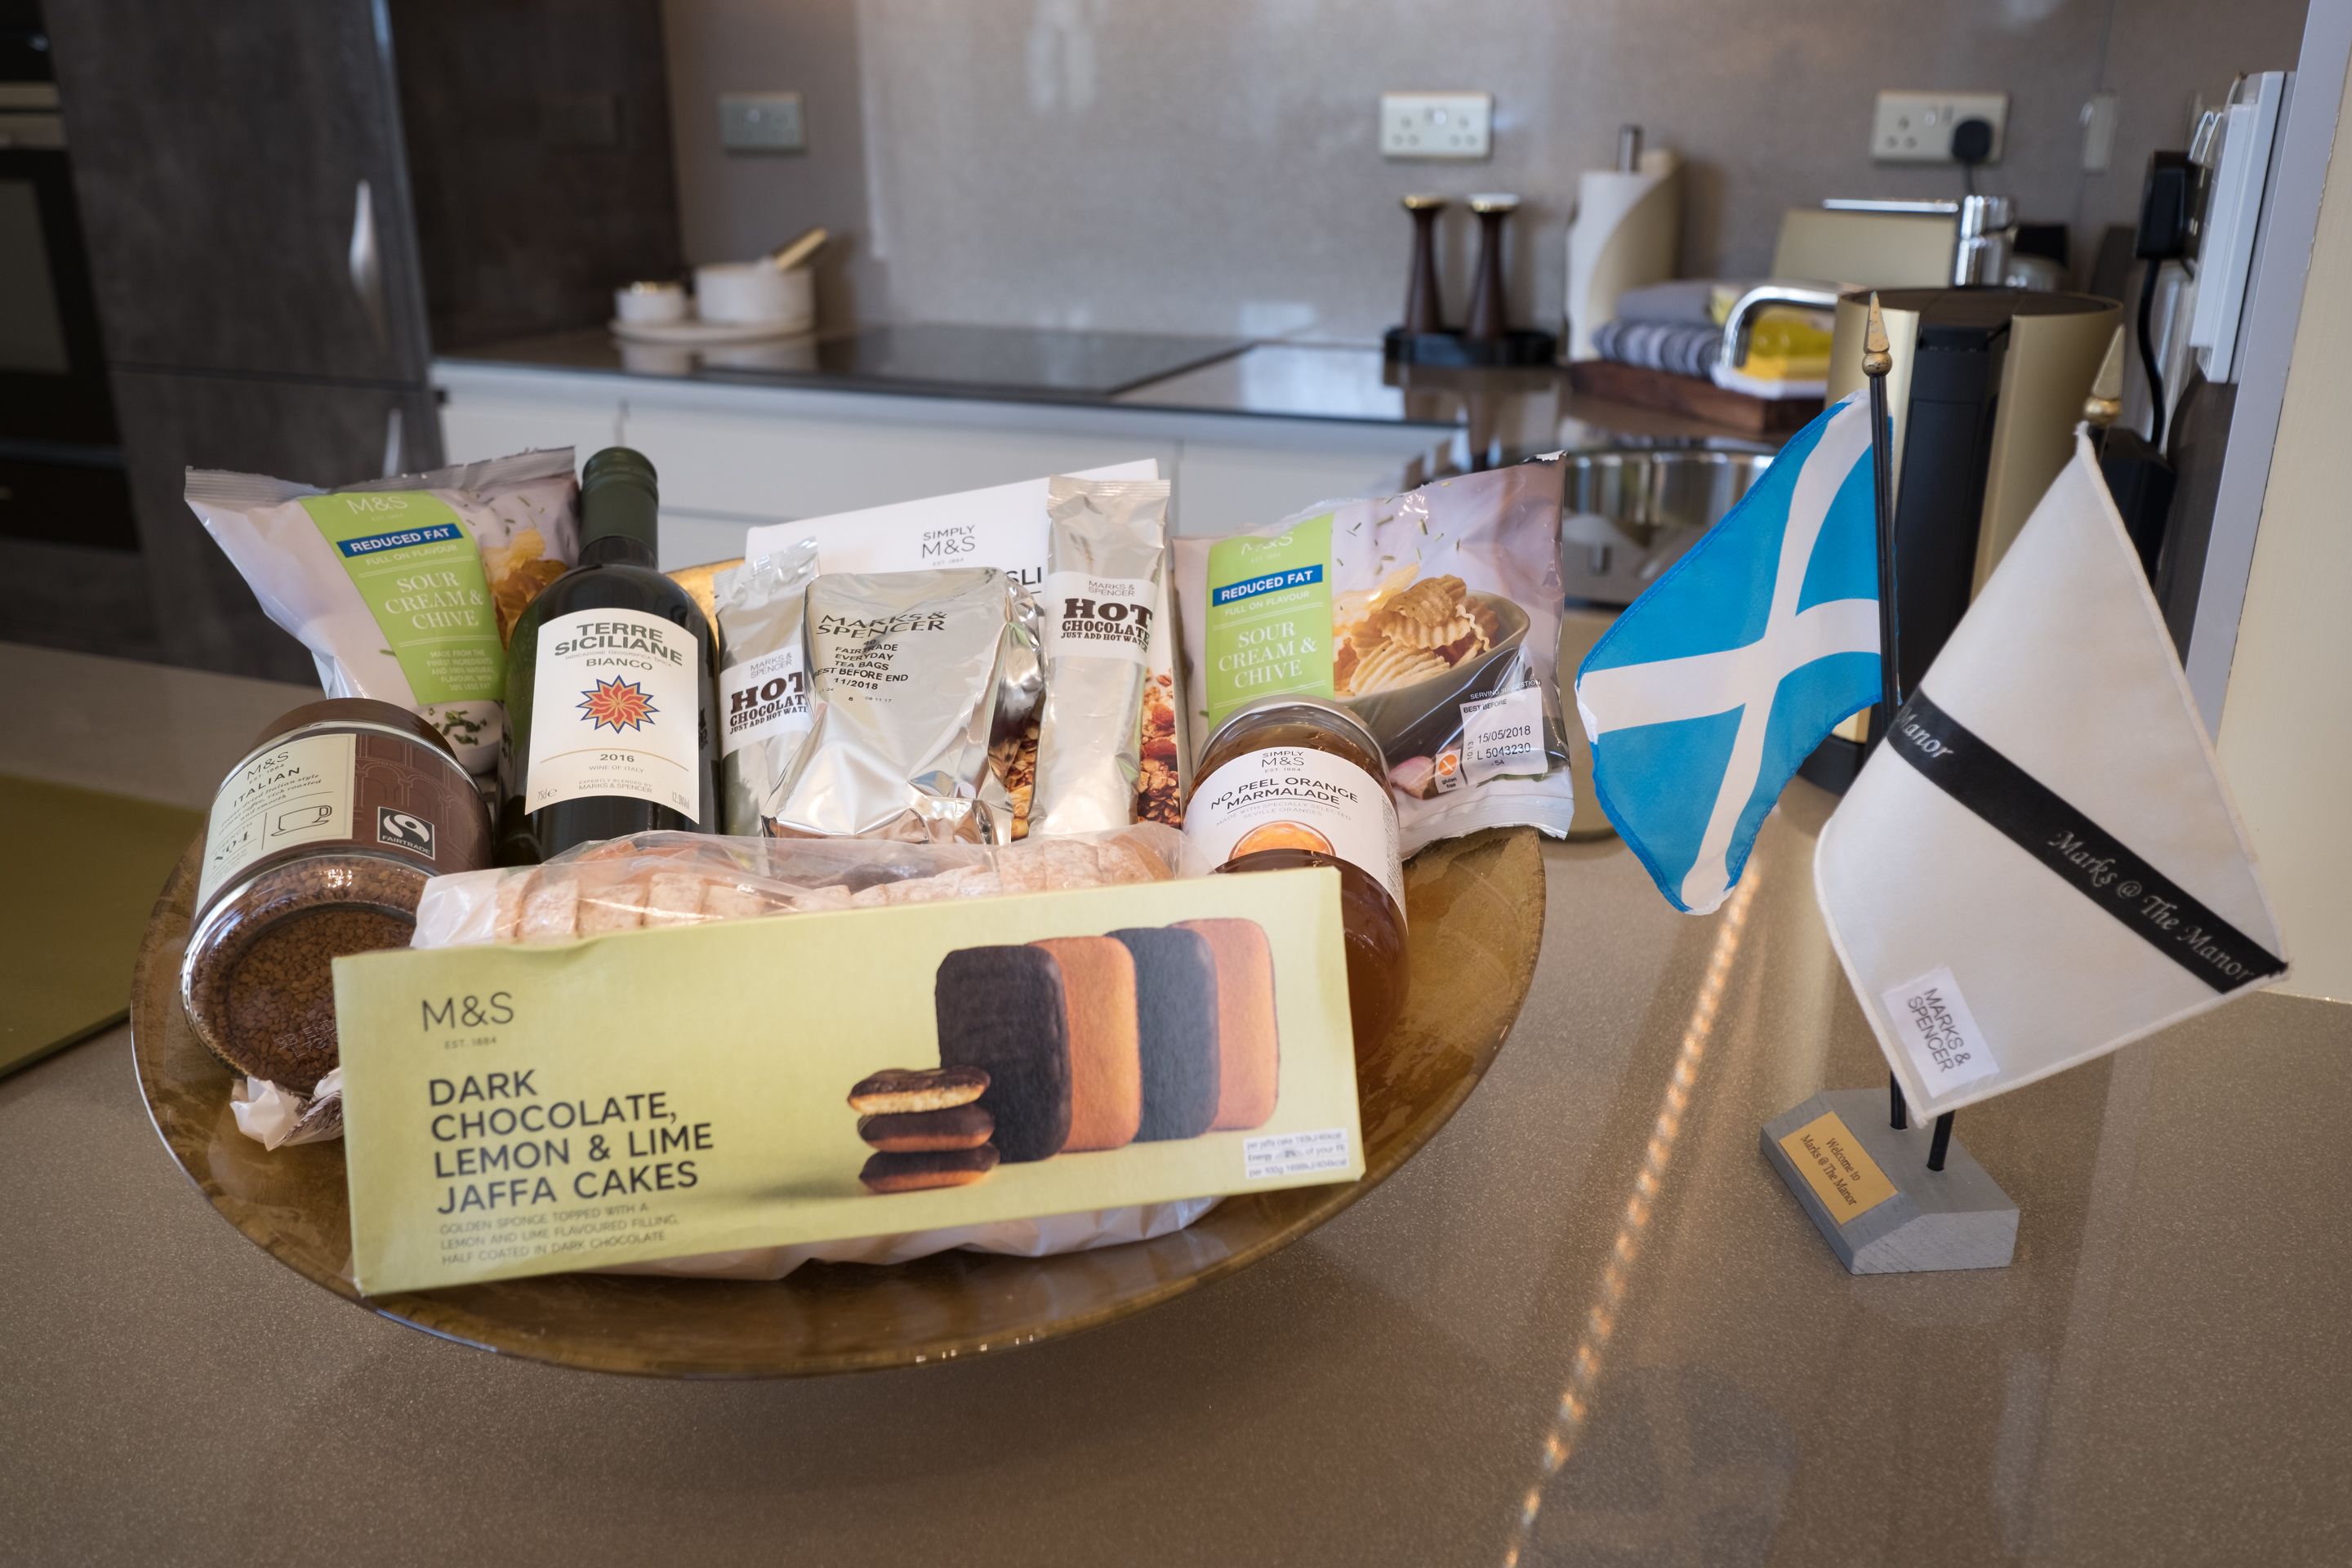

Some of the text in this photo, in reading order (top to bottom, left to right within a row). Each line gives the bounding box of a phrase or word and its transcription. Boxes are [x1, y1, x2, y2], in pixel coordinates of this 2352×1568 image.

[346, 496, 408, 515] M&S
[350, 528, 451, 553] REDUCED FAT
[924, 524, 976, 541] SIMPLY
[366, 544, 458, 566] FULL ON FLAVOUR
[922, 536, 976, 559] M&S
[397, 572, 460, 594] SOUR
[1088, 586, 1135, 597] SPENCER
[1089, 581, 1126, 590] MARKS
[1221, 570, 1314, 601] REDUCED FAT
[385, 589, 484, 614] CREAM &
[1225, 590, 1311, 617] FULL ON FLAVOUR
[412, 609, 479, 630] CHIVE
[821, 612, 948, 629] MARKS &
[1063, 598, 1153, 631] HOT
[577, 622, 664, 644] TERRE
[817, 620, 946, 639] SPENCER
[1061, 631, 1083, 639] JUST
[1084, 632, 1102, 640] ADD
[1062, 620, 1150, 646] CHOCOLATE
[1238, 621, 1296, 648] SOUR
[555, 635, 684, 666] SICILIANE
[835, 653, 894, 662] EVERYDAY
[1218, 636, 1318, 673] CREAM &
[586, 657, 653, 671] BIANCO
[751, 654, 785, 671] MARKS
[751, 659, 793, 679] SPENCER
[835, 660, 889, 670] TEA BAGS
[1234, 659, 1303, 688] CHIVE
[834, 678, 879, 690] 11/2018
[839, 668, 884, 681] BEFORE
[885, 674, 909, 682] END
[730, 671, 804, 715] HOT
[1470, 688, 1499, 701] SERVING
[730, 693, 807, 728] CHOCOLAT
[1463, 705, 1481, 714] BEST
[729, 723, 749, 735] JUST
[750, 717, 765, 728] ADD
[766, 710, 782, 722] HOT
[1477, 725, 1531, 744] 15/05/2018
[599, 754, 635, 763] 2016
[1262, 756, 1305, 768] M&S
[1263, 751, 1304, 759] SIMPLY
[1477, 742, 1531, 760] L 5043230
[247, 751, 289, 781] M&S
[624, 766, 645, 774] ITALY
[234, 767, 301, 808] ITALIAN
[578, 782, 608, 791] MARKS
[617, 782, 653, 794] SPENCER
[1210, 777, 1359, 811] NO PEEL ORANGE
[1227, 787, 1340, 811] MARMALADE
[1240, 805, 1260, 816] WITH
[382, 835, 431, 855] FAIRTRADE
[2047, 830, 2256, 981] Marks @ The Manor
[421, 991, 514, 1032] M&S
[1908, 996, 1954, 1073] SPENCER
[1924, 987, 1971, 1067] MARKS &
[444, 1039, 468, 1050] EST.
[429, 1069, 538, 1107] DARK
[430, 1091, 678, 1143] CHOCOLATE,
[434, 1122, 714, 1178] LEMON & LIME
[1825, 1137, 1861, 1182] Welcome to
[1800, 1134, 1858, 1206] Marks @ The Manor
[437, 1160, 699, 1215] JAFFA CAKES
[439, 1202, 648, 1235] GOLDEN SPONGE TOPPED WITH A
[440, 1236, 486, 1250] LEMON
[491, 1232, 517, 1244] AND
[522, 1228, 550, 1241] LIME
[555, 1219, 628, 1236] FLAVOURED
[442, 1230, 666, 1265] HALF COATED IN DARK CHOCOLATE
